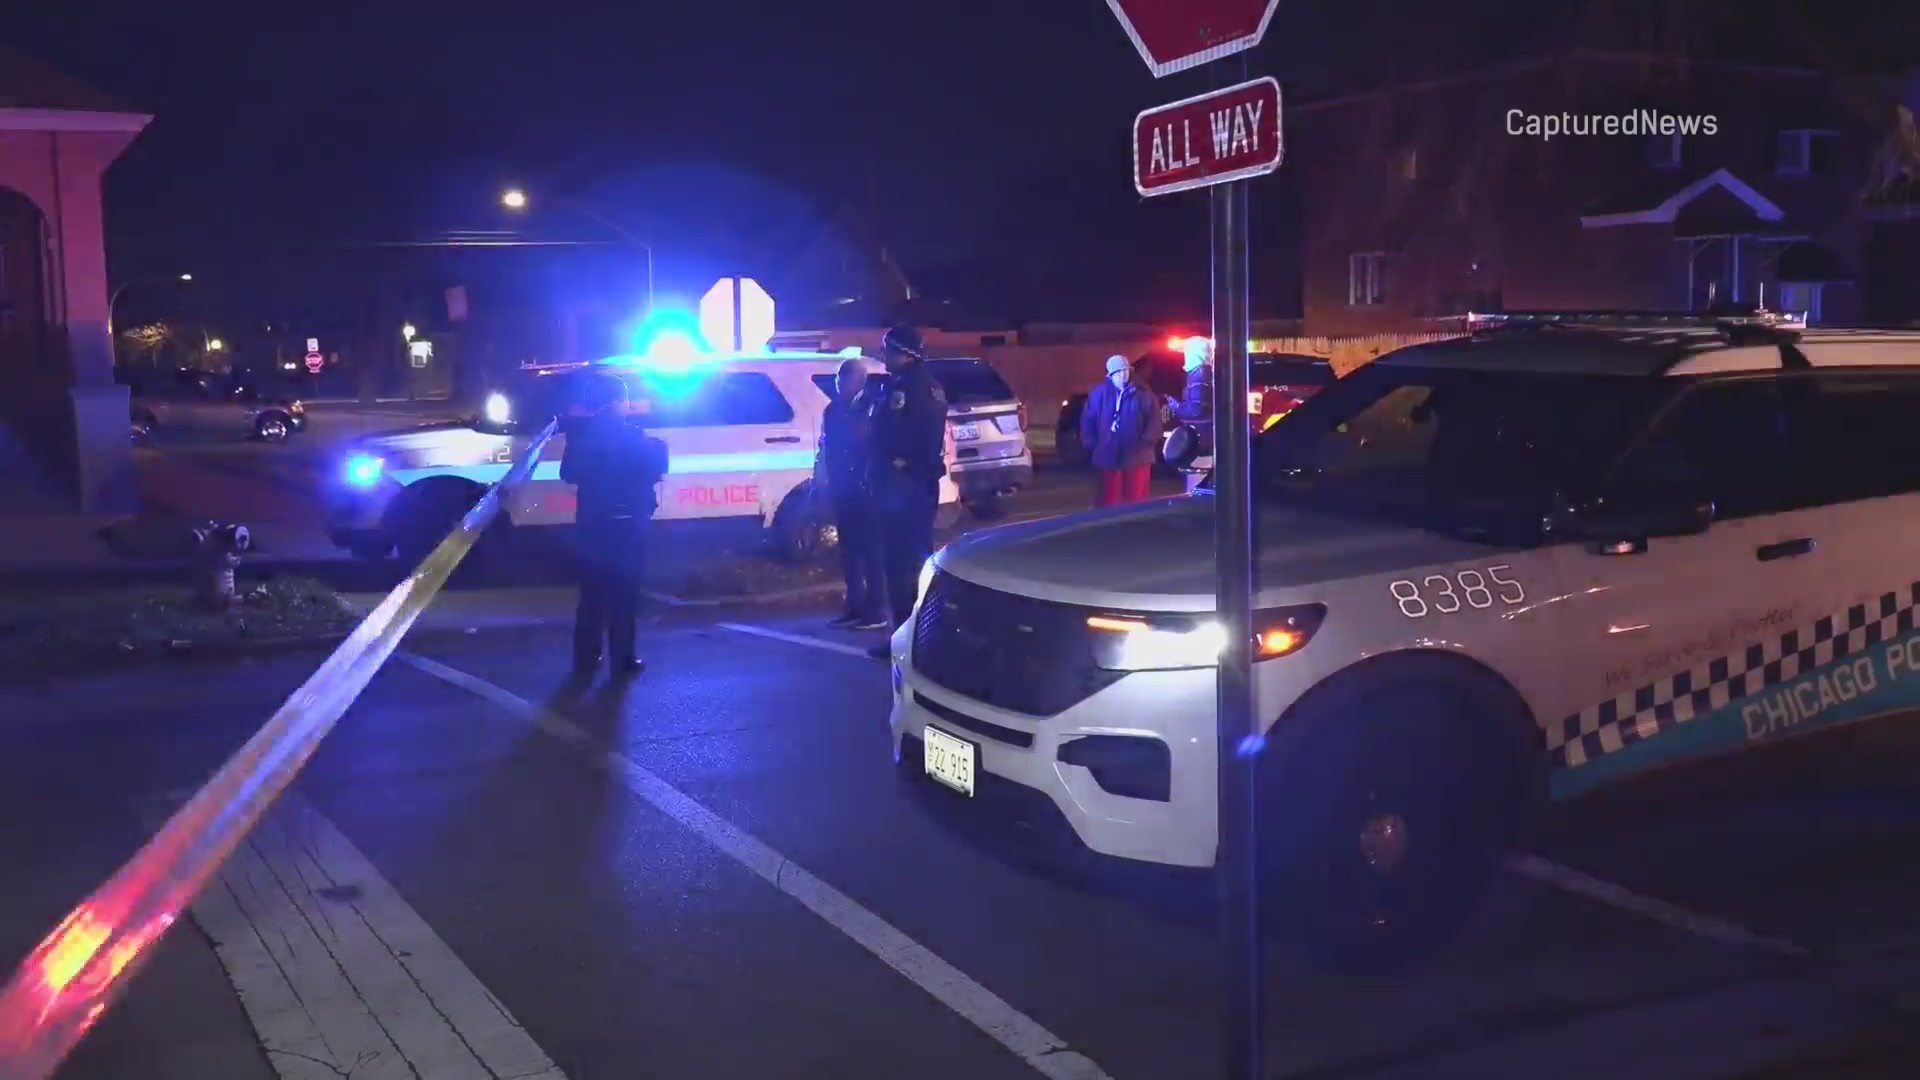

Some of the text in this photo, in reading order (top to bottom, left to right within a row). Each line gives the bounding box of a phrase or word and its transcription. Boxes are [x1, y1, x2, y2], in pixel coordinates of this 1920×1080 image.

[1150, 99, 1263, 174] ALL WAY
[677, 484, 760, 506] POLICE
[1390, 565, 1524, 617] 8385
[1742, 656, 1876, 740] CHICAGO
[951, 753, 968, 783] 915
